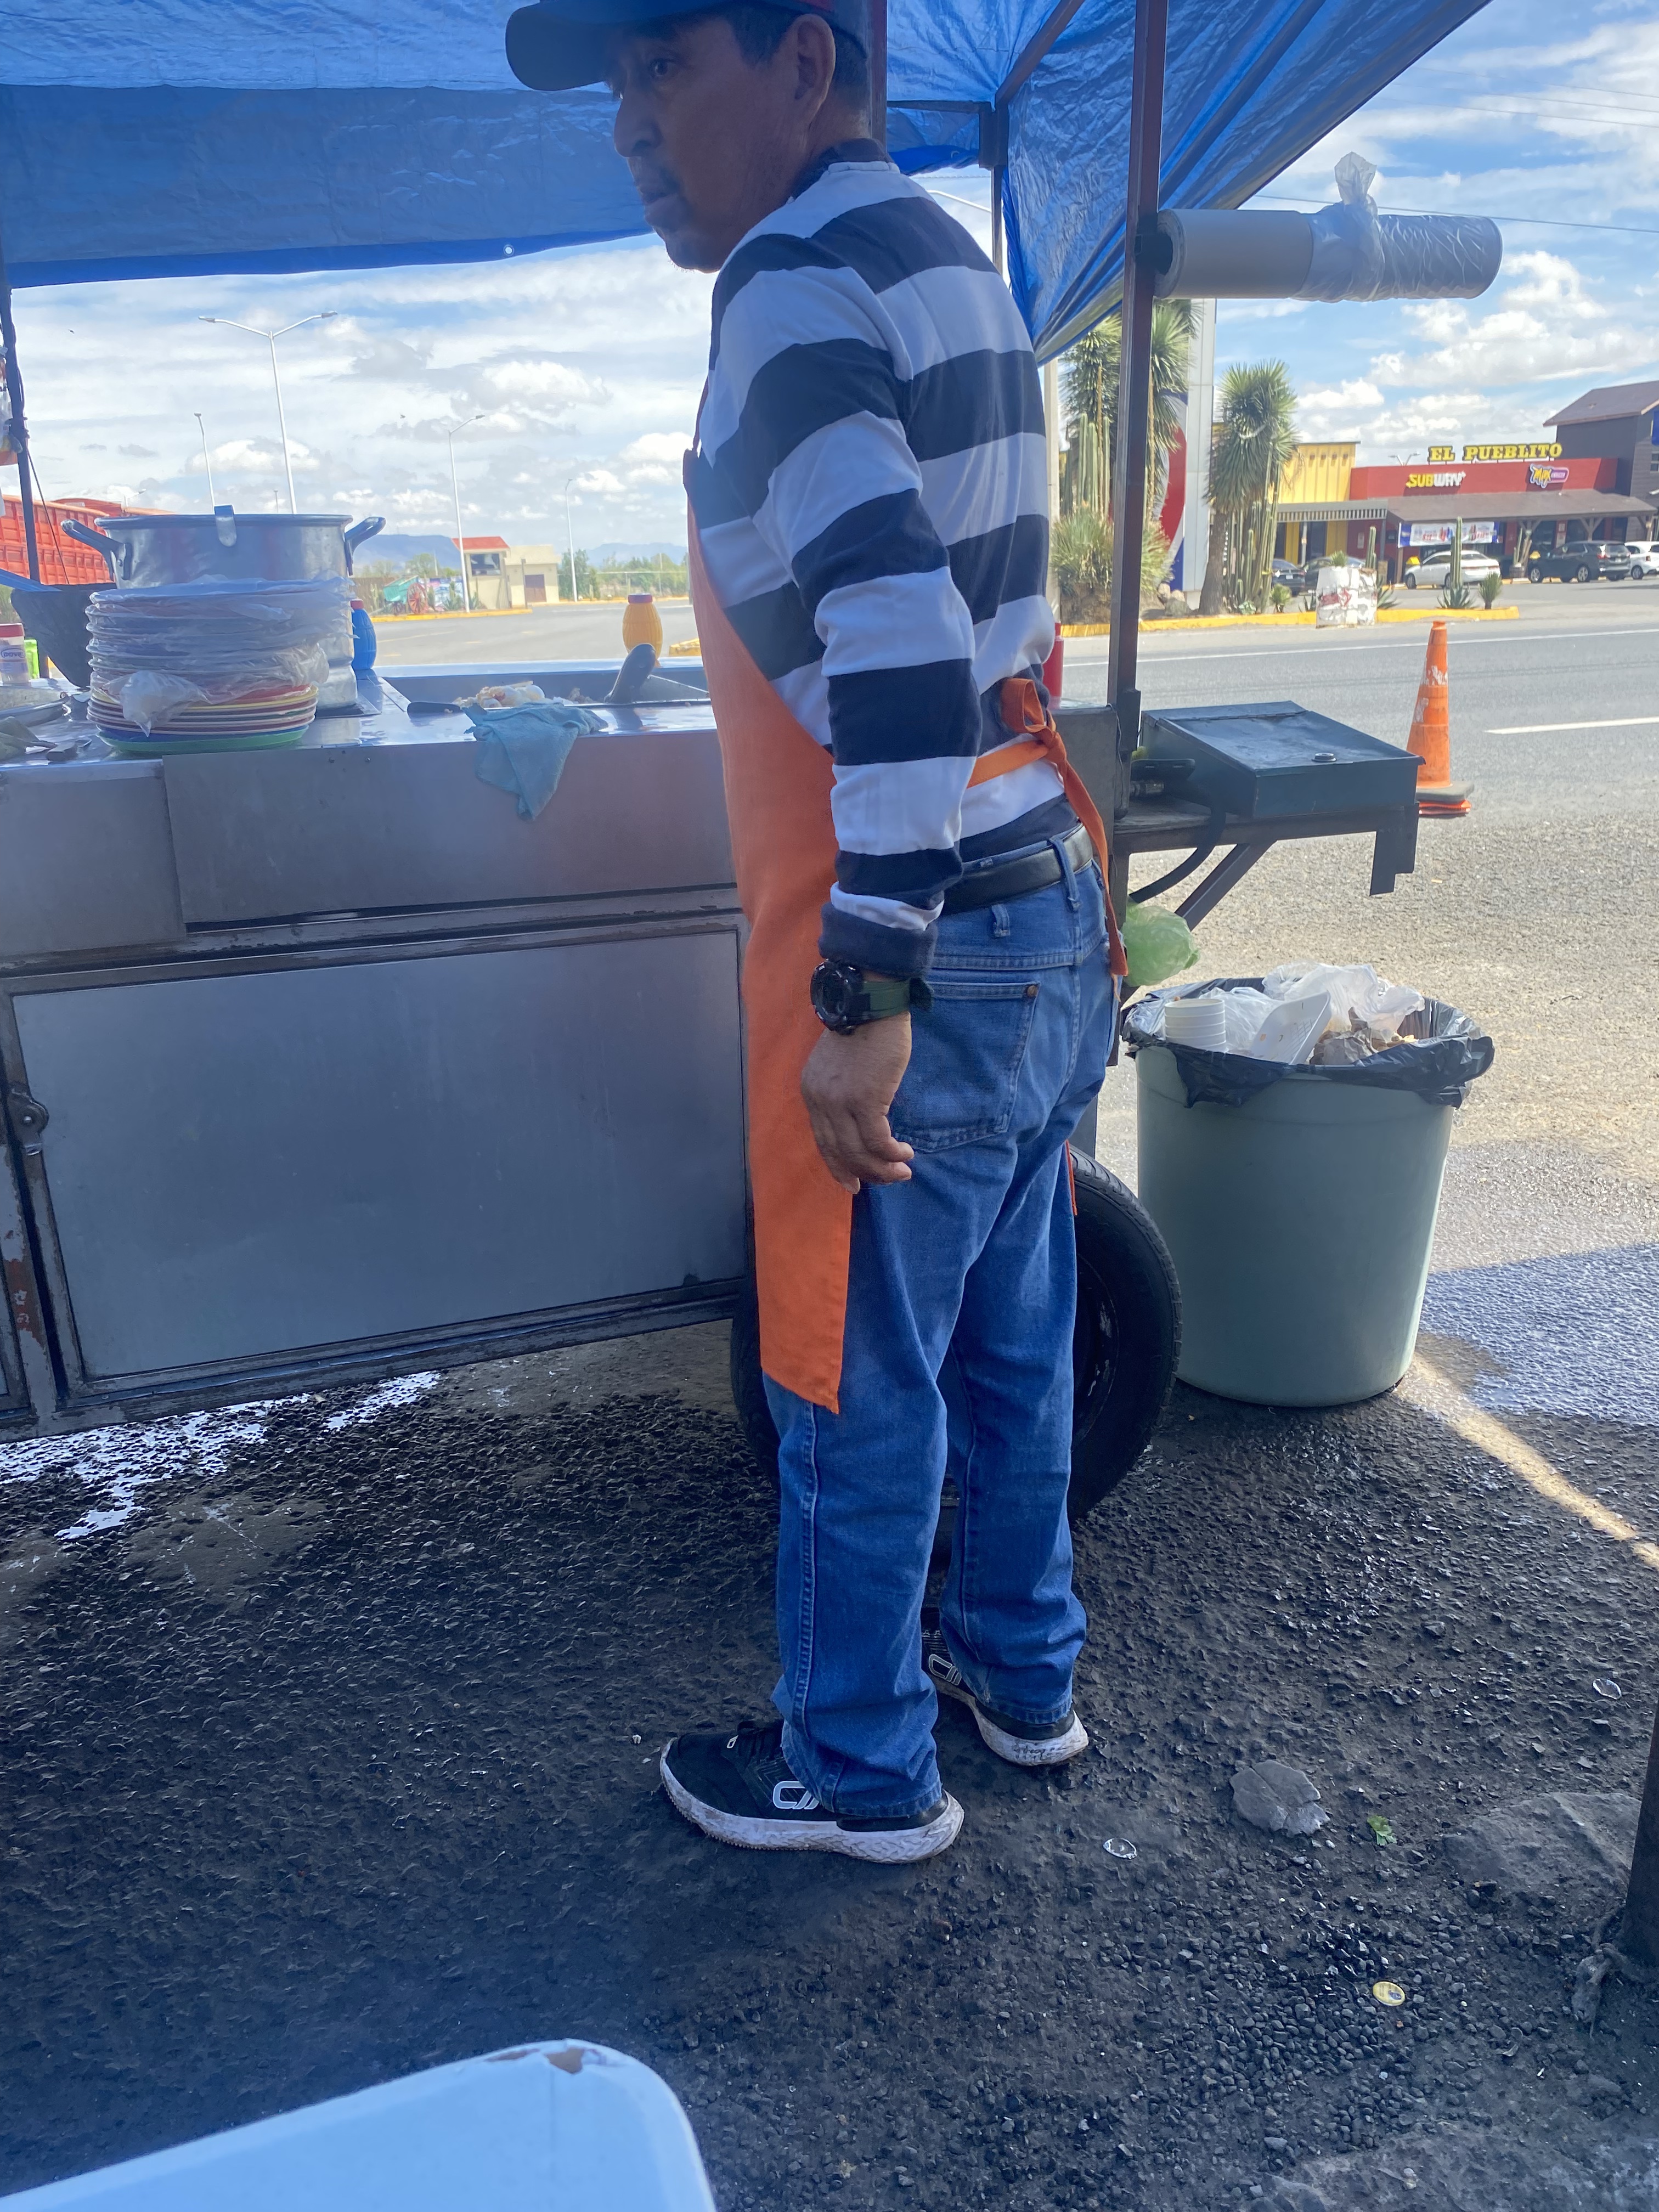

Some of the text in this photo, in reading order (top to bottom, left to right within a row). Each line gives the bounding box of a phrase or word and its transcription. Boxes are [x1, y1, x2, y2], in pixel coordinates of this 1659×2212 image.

[1428, 443, 1562, 461] EL PUEBLITO
[1406, 471, 1466, 488] SUBWAY
